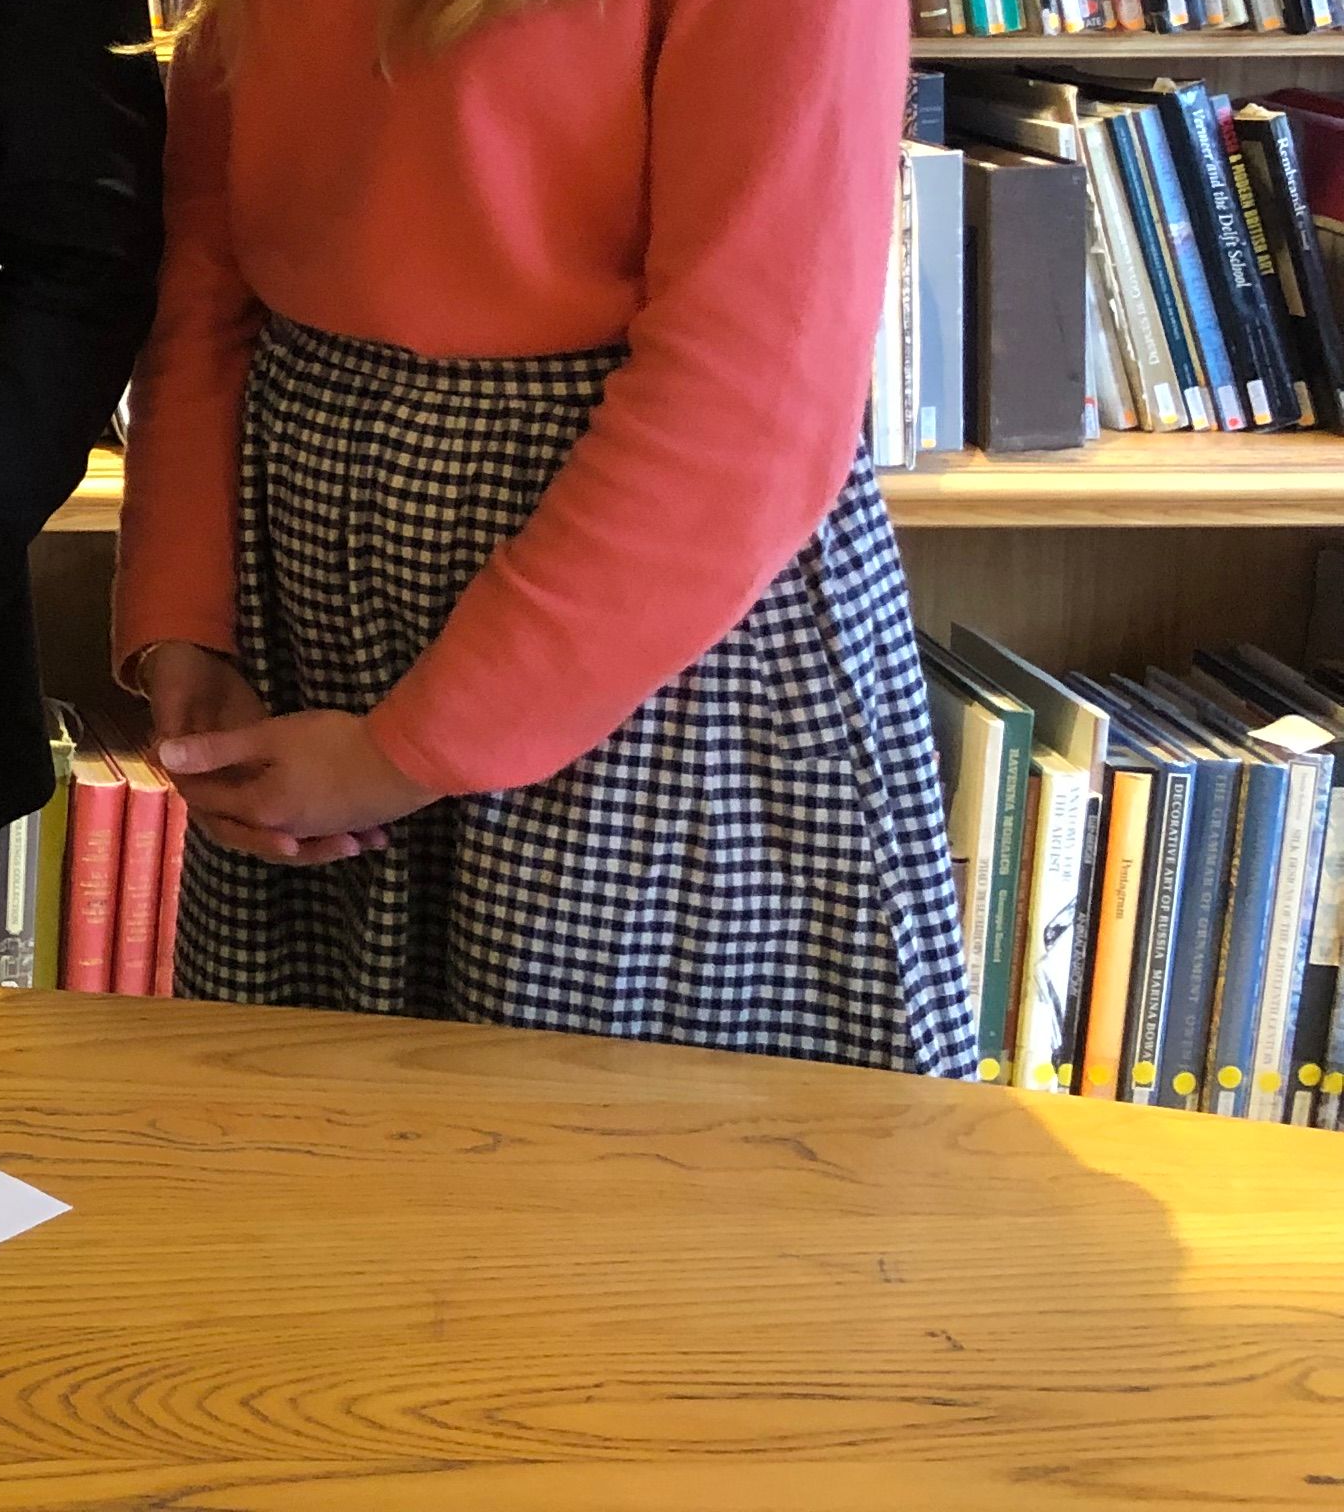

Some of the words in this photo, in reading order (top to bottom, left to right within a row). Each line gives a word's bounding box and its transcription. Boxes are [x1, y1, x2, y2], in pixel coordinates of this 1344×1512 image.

[1192, 108, 1215, 161] Vermeer
[1207, 164, 1223, 188] and
[1233, 165, 1252, 208] MODERN
[1276, 137, 1304, 216] Rembrandt
[1211, 192, 1228, 211] the
[1242, 210, 1263, 252] BRITISH
[1227, 250, 1252, 288] School
[1258, 255, 1275, 275] ART
[1164, 783, 1185, 863] DECORATIVE
[1115, 858, 1132, 920] Pentagram
[1163, 868, 1177, 891] ART
[1160, 895, 1174, 912] OF
[1154, 916, 1172, 959] RUSSIA
[1146, 970, 1162, 1019] MARINA
